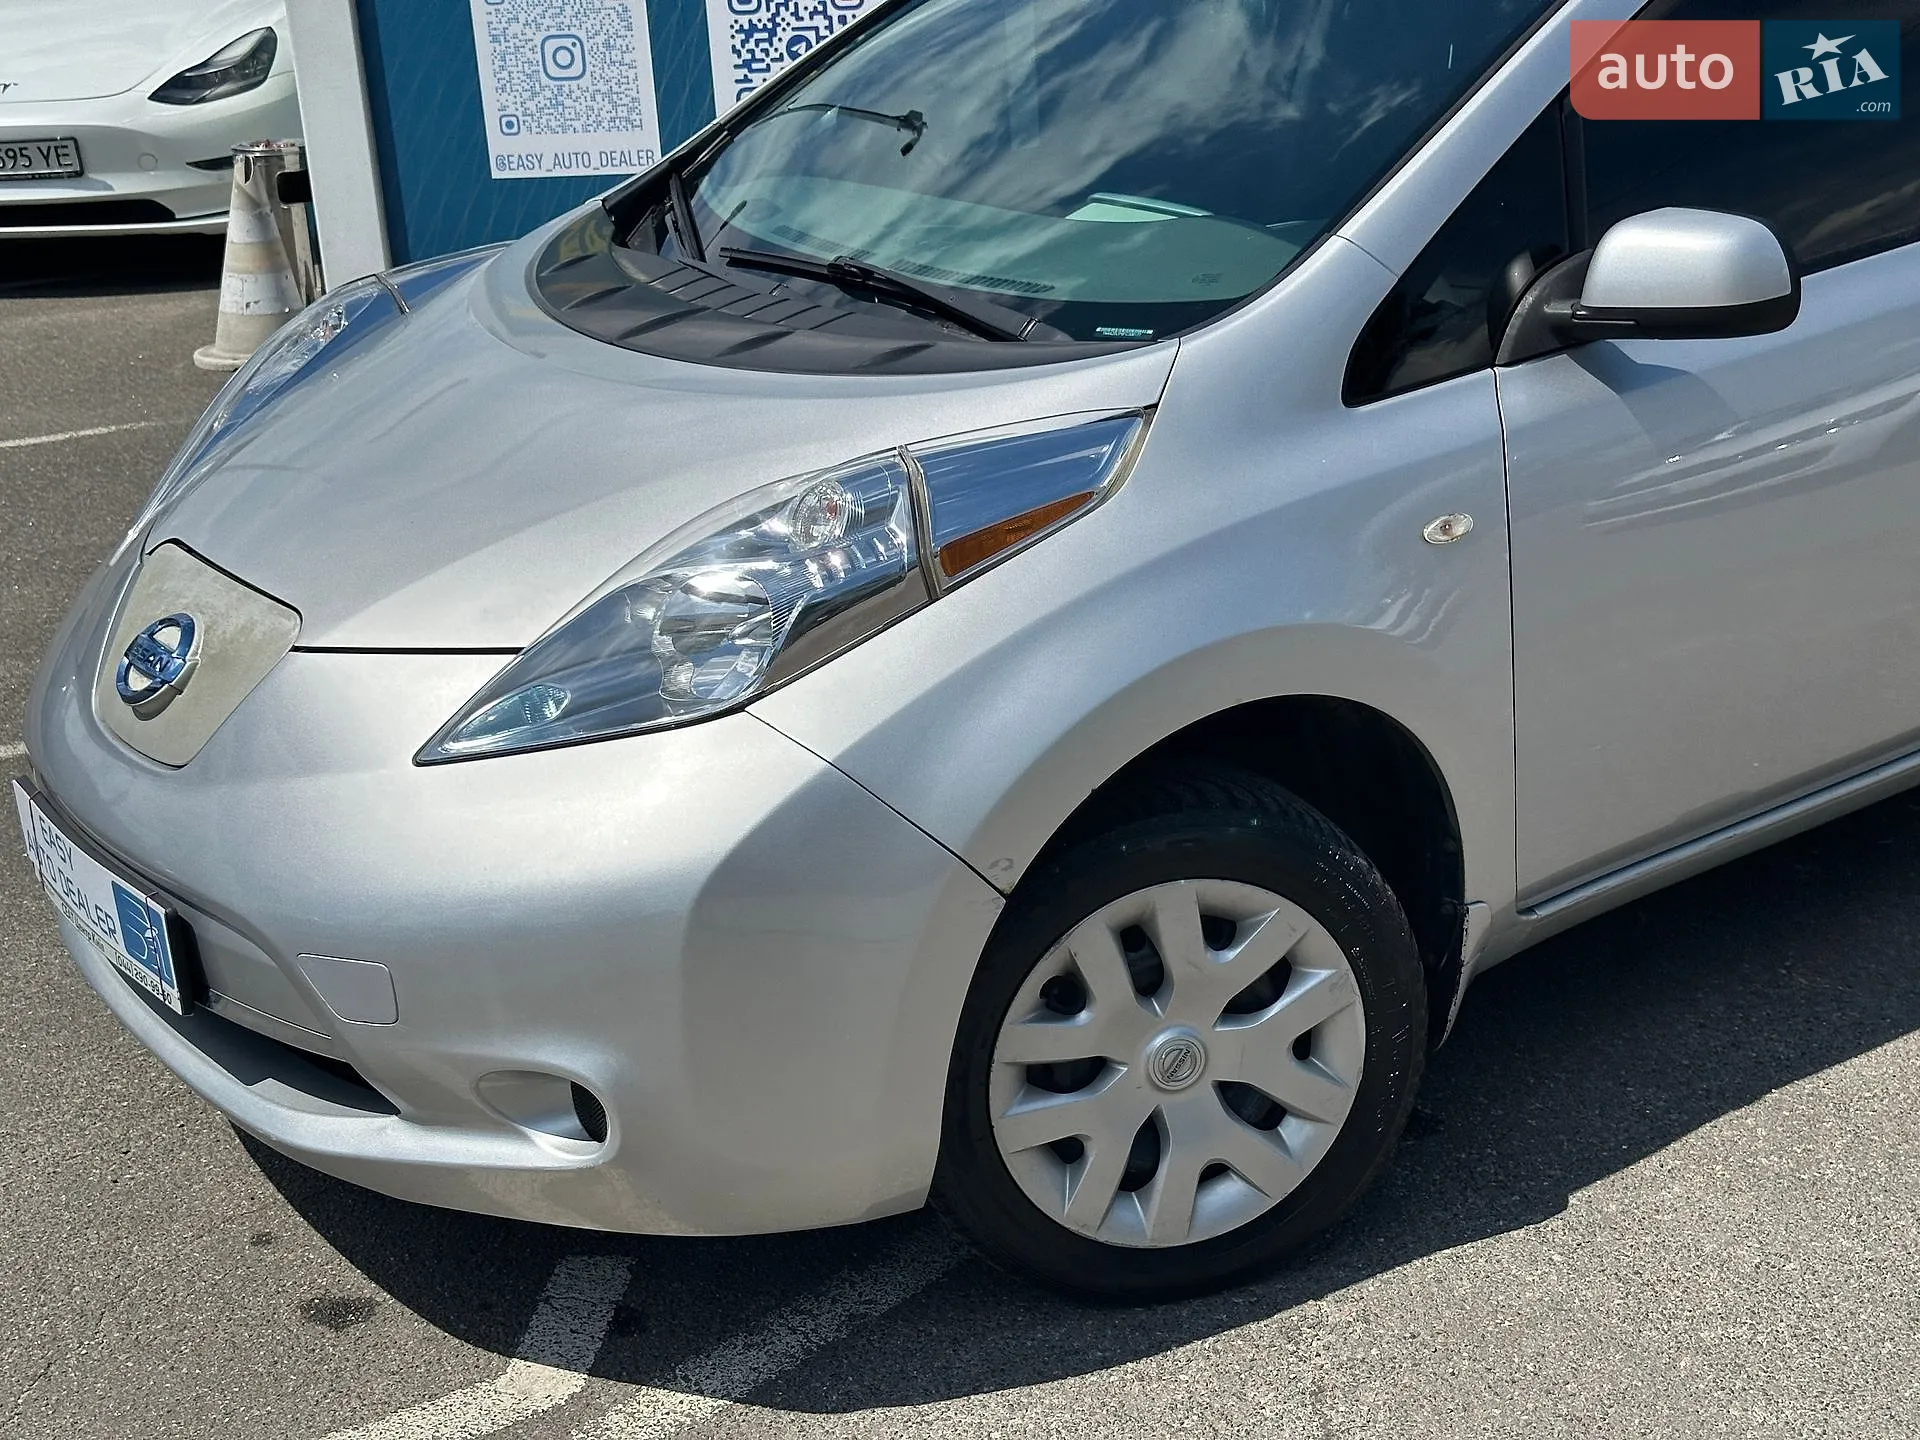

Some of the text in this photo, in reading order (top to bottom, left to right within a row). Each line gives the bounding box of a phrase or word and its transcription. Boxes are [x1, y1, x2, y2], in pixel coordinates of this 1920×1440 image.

[37, 144, 73, 168] YE
[494, 148, 656, 173] @EASY_AUTO_DEALER
[39, 814, 74, 871] EASY
[58, 867, 119, 944] DEALER
[1166, 1048, 1191, 1080] NISSAN
